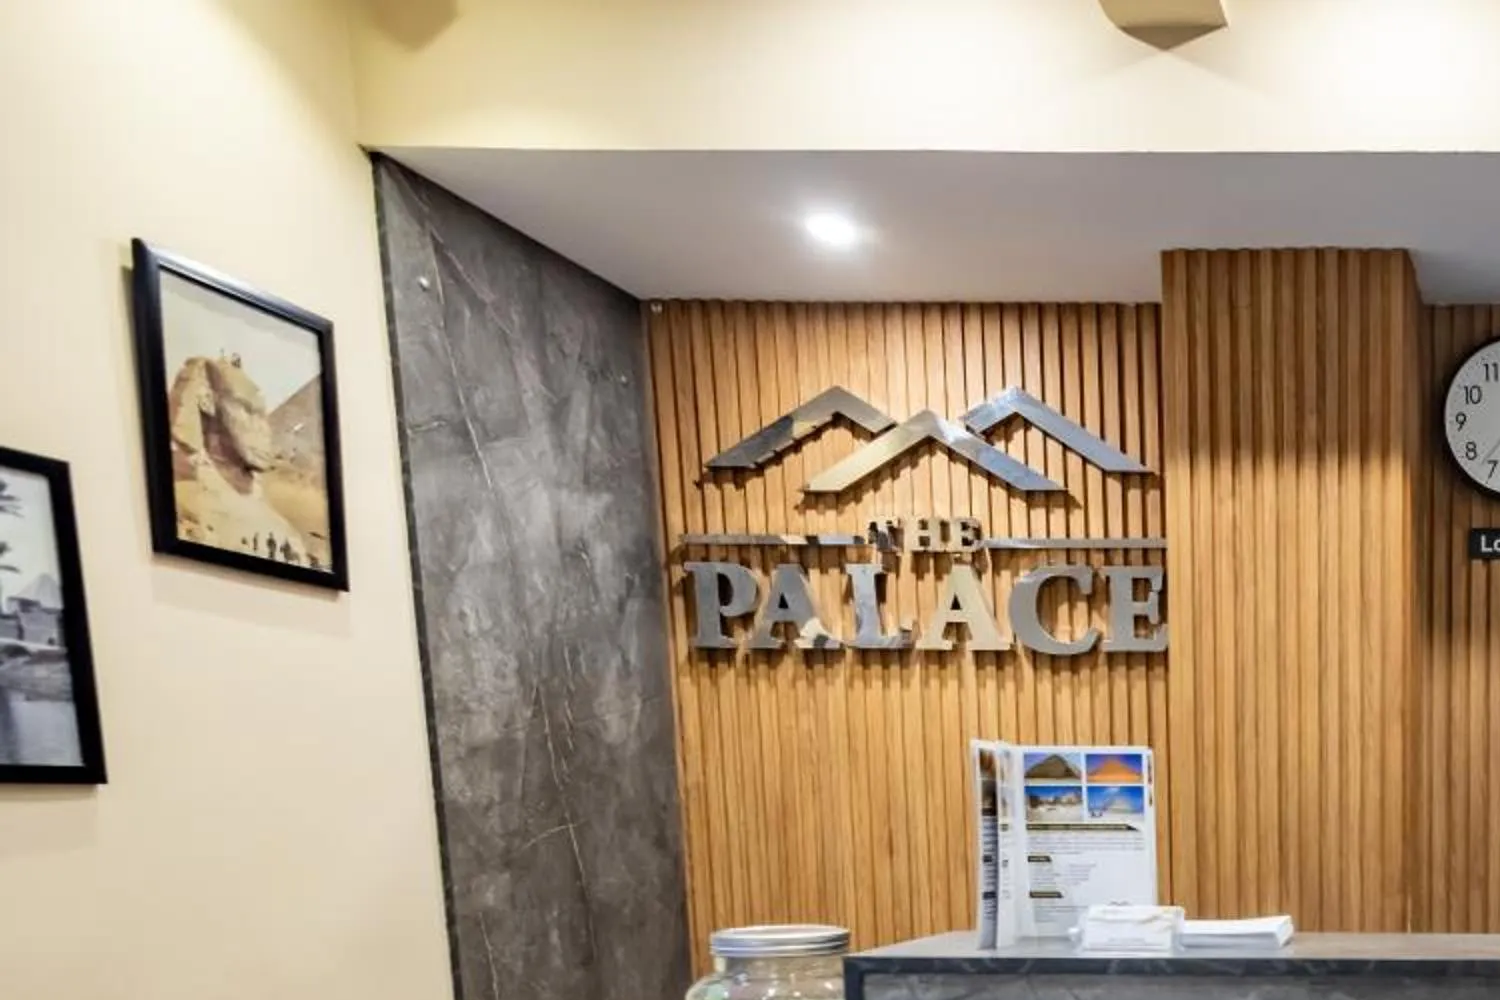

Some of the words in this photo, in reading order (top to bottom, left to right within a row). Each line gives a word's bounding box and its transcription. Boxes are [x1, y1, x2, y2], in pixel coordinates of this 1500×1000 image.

[1484, 362, 1499, 382] 11
[1464, 385, 1482, 404] 10
[1456, 412, 1466, 431] 9
[1465, 442, 1477, 461] 8
[1488, 460, 1498, 479] 7
[867, 517, 982, 552] THE
[685, 561, 1168, 655] PALACE
